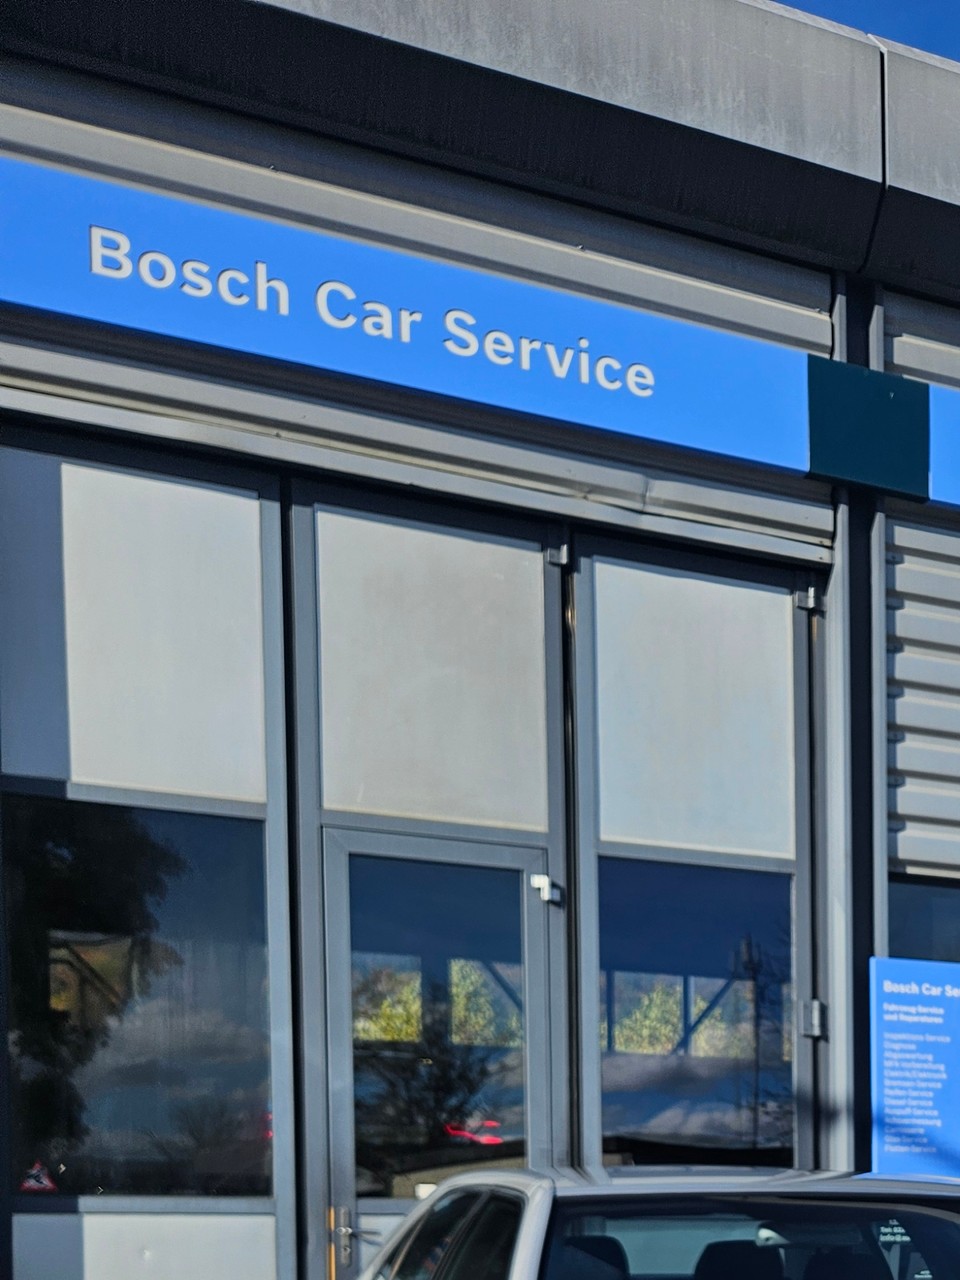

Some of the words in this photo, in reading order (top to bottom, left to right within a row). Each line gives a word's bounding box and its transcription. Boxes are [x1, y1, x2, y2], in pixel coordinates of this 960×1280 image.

[89, 224, 290, 316] Bosch
[314, 279, 423, 343] Car
[443, 308, 656, 398] Service
[883, 980, 919, 994] Bosch
[921, 983, 942, 997] Car
